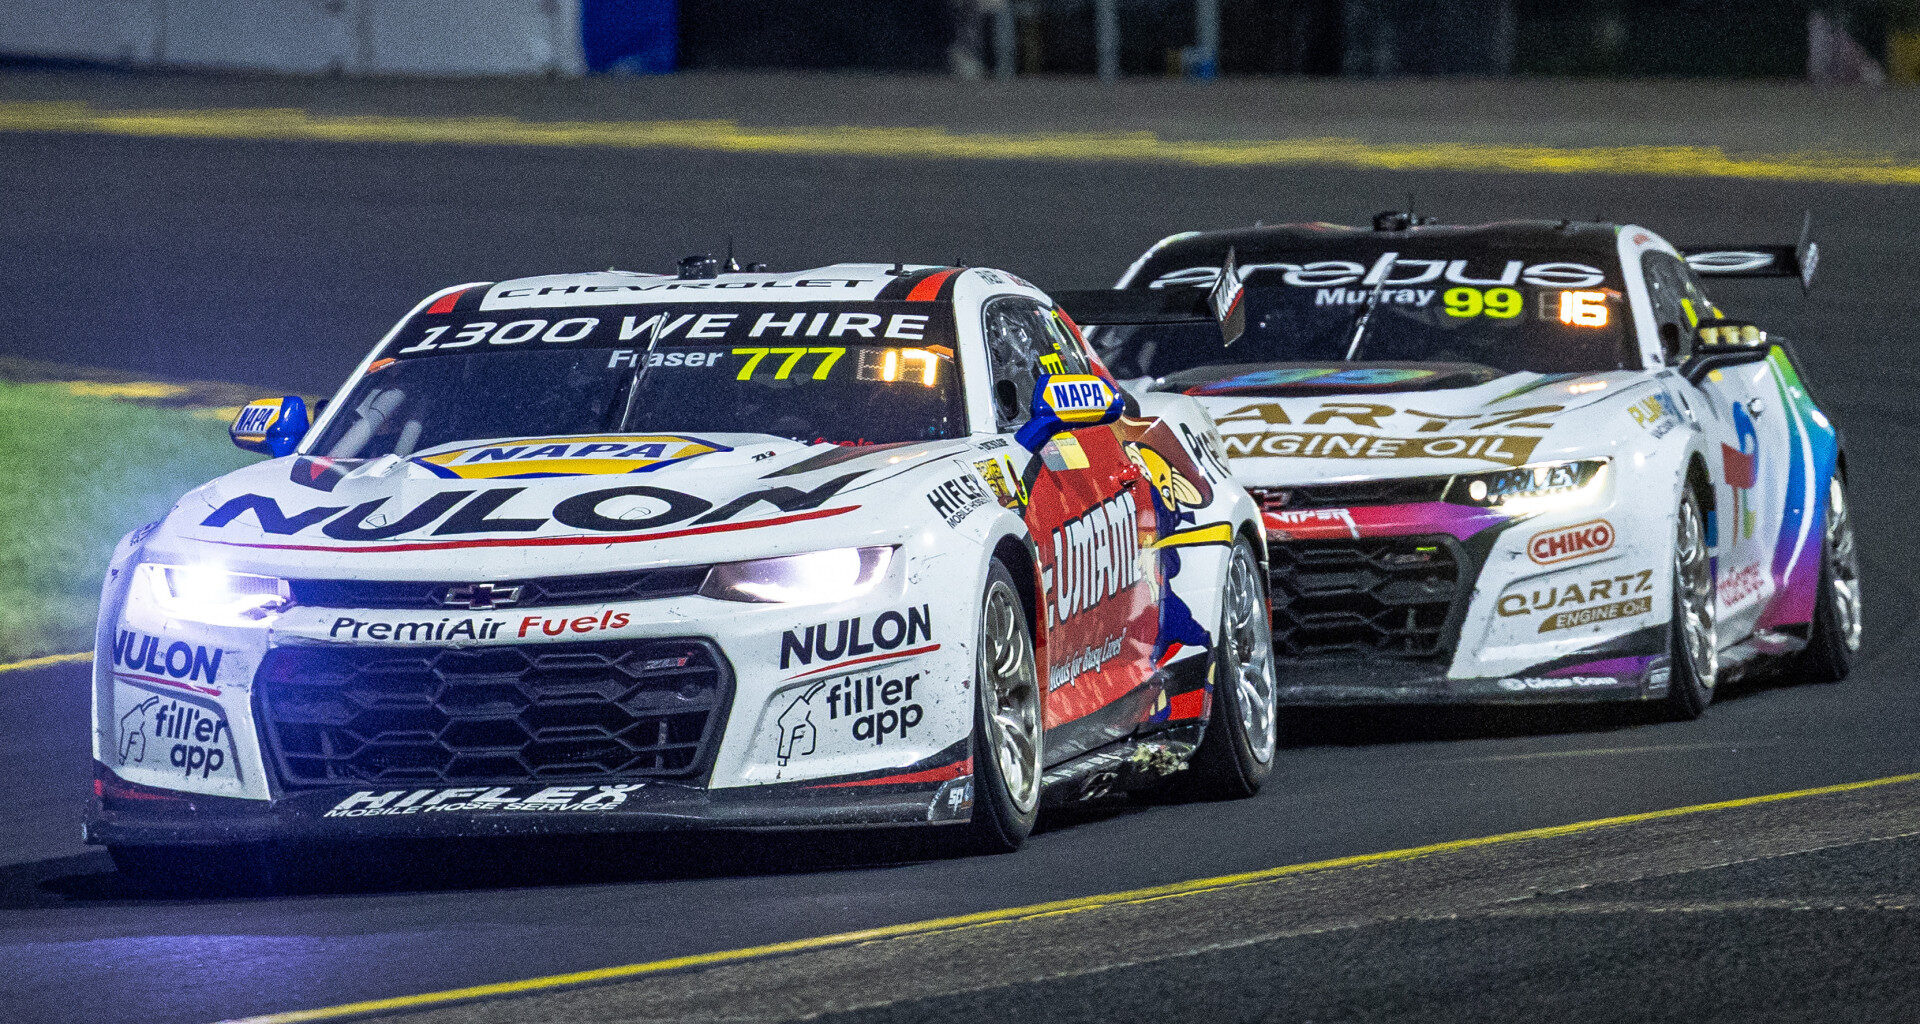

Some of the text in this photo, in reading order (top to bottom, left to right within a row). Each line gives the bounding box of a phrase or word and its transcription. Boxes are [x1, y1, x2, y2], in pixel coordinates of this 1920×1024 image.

[1149, 252, 1606, 288] erebus
[497, 279, 874, 299] CHEVROLET
[1443, 286, 1524, 319] 99
[1559, 290, 1609, 328] 16
[399, 312, 930, 354] 1300 WE HIRE
[607, 349, 724, 369] Fraser
[731, 347, 847, 381] 777
[882, 348, 938, 388] 17
[1053, 383, 1106, 408] NAPA
[235, 407, 275, 432] NAPA
[1214, 402, 1566, 433] ARTZ
[466, 443, 664, 463] NAPA
[1222, 434, 1514, 460] NGINE OIL
[199, 469, 876, 541] NULON
[1533, 525, 1610, 560] CHIKO
[1497, 569, 1654, 618] QUARTZ
[329, 609, 631, 641] PremiAir Fuels
[1556, 600, 1648, 628] ENGINE OIL
[779, 603, 932, 670] NULON
[113, 630, 224, 685] NULON
[827, 673, 920, 720] fill'er
[155, 700, 229, 744] fill'er
[852, 703, 924, 746] app
[169, 743, 225, 779] app
[323, 801, 620, 818] MOBILE HOSE SERVICE
[335, 783, 646, 810] HIFLEX
